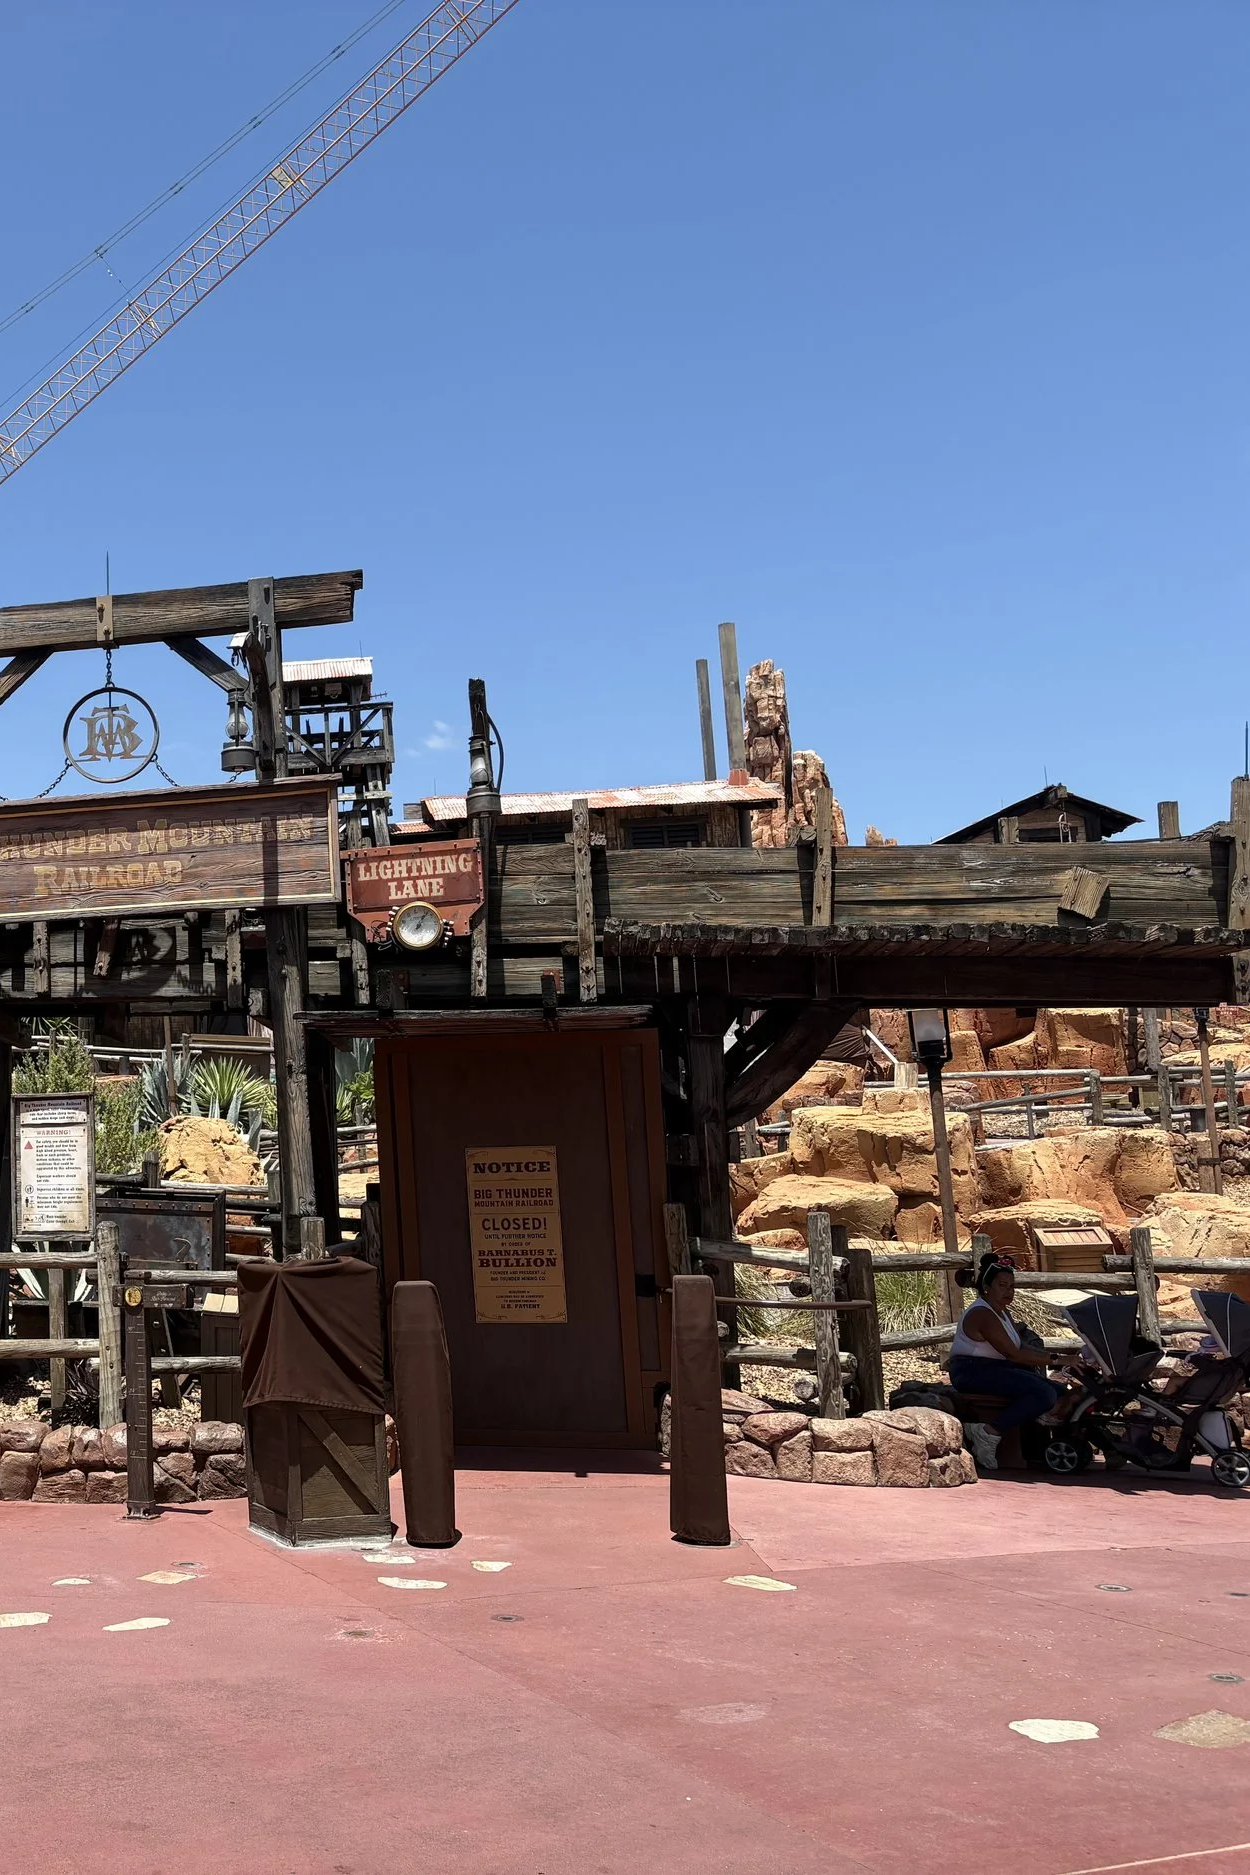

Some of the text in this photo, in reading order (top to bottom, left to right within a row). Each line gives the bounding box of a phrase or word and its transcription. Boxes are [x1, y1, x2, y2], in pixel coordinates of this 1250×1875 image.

[137, 813, 313, 854] MOUNTAIN
[357, 853, 472, 881] LIGHTNING
[33, 860, 182, 897] RAILROAD
[388, 878, 444, 900] LANE
[473, 1161, 550, 1173] NOTICE
[474, 1188, 552, 1200] BIG THUNDER
[474, 1199, 554, 1208] MOUNTAIN RAILROAD
[482, 1217, 547, 1230] CLOSED!
[546, 1248, 557, 1256] T.
[478, 1258, 558, 1268] BULLION
